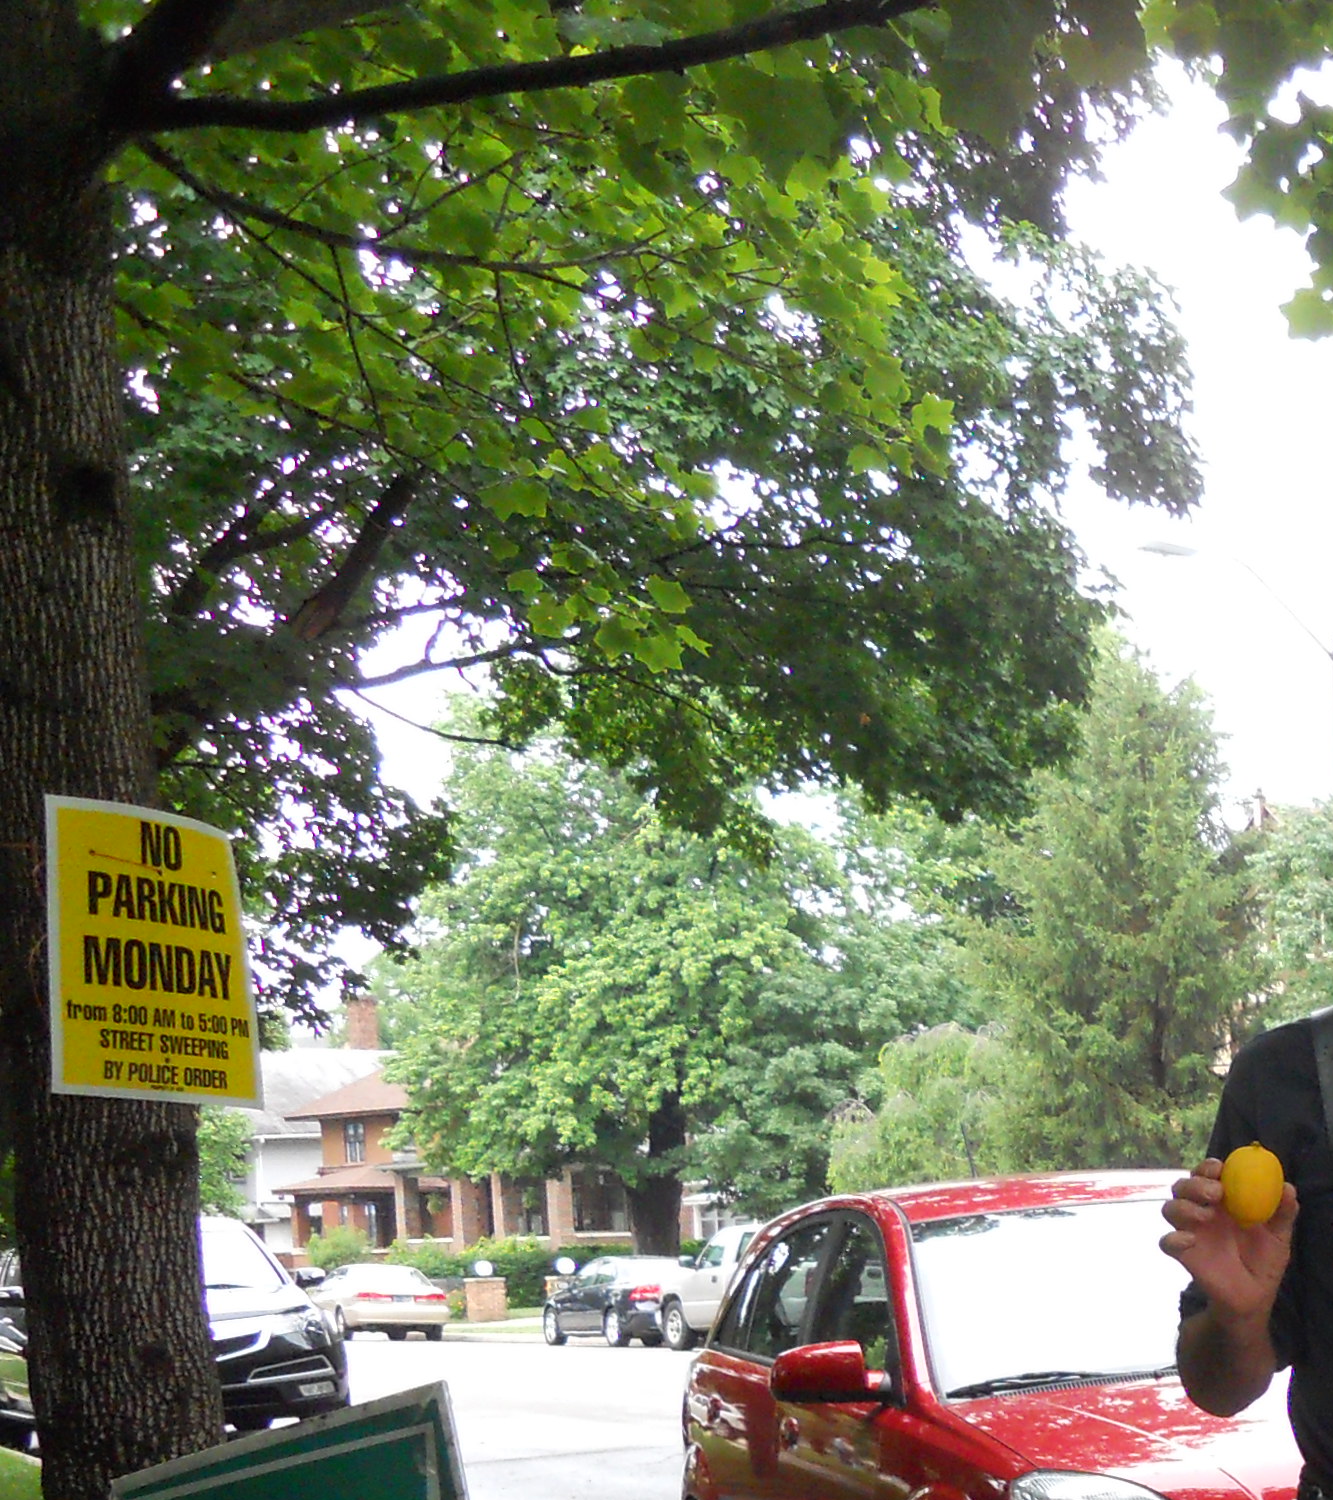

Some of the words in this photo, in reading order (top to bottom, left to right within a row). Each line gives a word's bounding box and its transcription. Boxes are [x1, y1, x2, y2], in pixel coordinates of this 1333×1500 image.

[140, 821, 182, 871] NO
[88, 870, 226, 935] PARKING
[83, 935, 231, 1000] MONDAY
[67, 1000, 107, 1021] from
[113, 1004, 147, 1025] 8:00
[153, 1010, 176, 1029] AM
[180, 1011, 194, 1030] to
[199, 1013, 228, 1034] 5:00
[231, 1019, 249, 1039] PM
[100, 1029, 153, 1051] STREET
[160, 1034, 229, 1060] SWEEPING
[104, 1061, 123, 1080] BY
[128, 1063, 179, 1085] POLICE
[183, 1067, 228, 1090] ORDER
